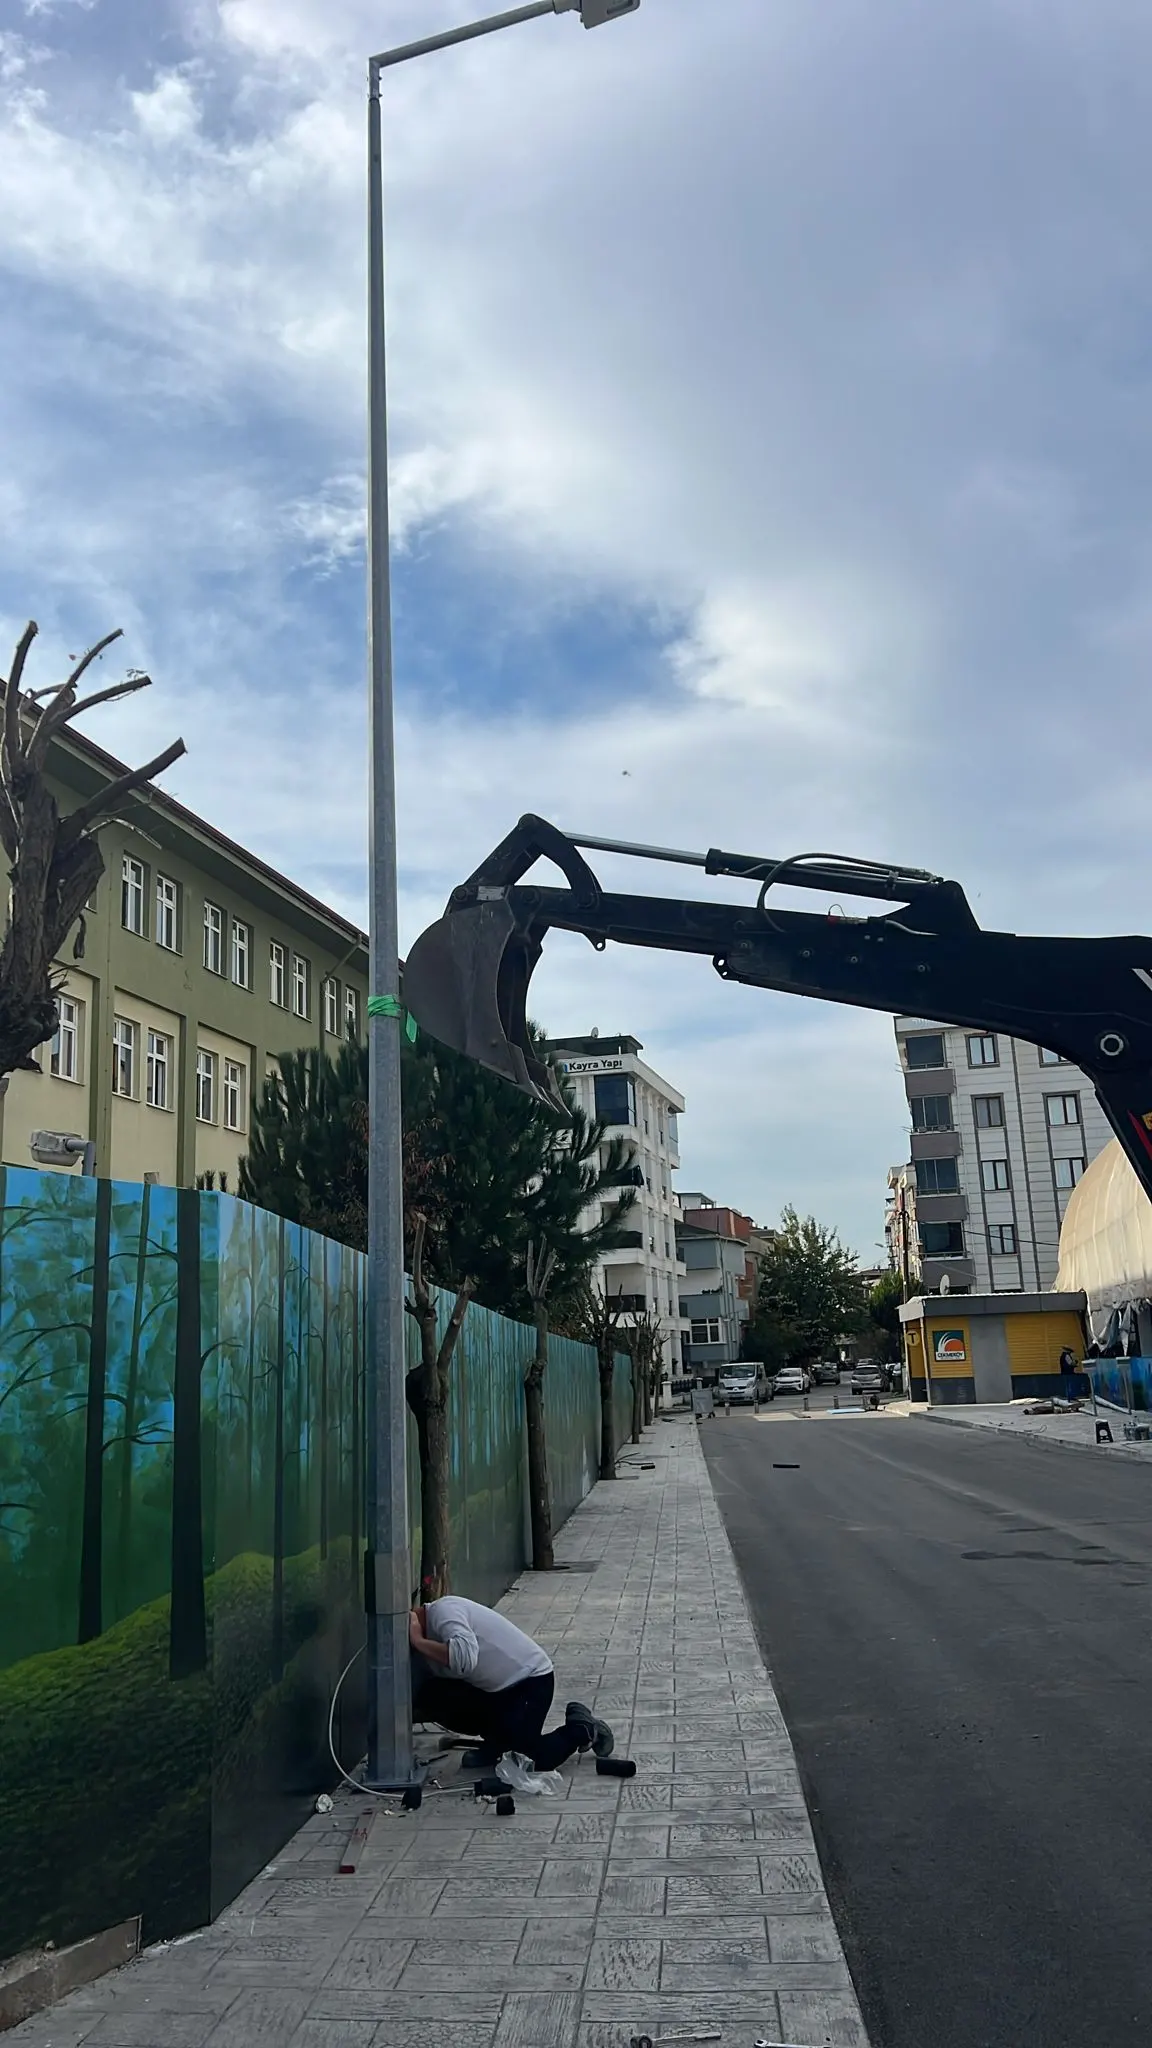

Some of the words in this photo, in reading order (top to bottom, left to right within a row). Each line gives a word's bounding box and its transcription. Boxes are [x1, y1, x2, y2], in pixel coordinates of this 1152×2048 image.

[569, 1062, 599, 1071] Kayra
[601, 1060, 622, 1068] Yapı
[908, 1333, 916, 1344] T
